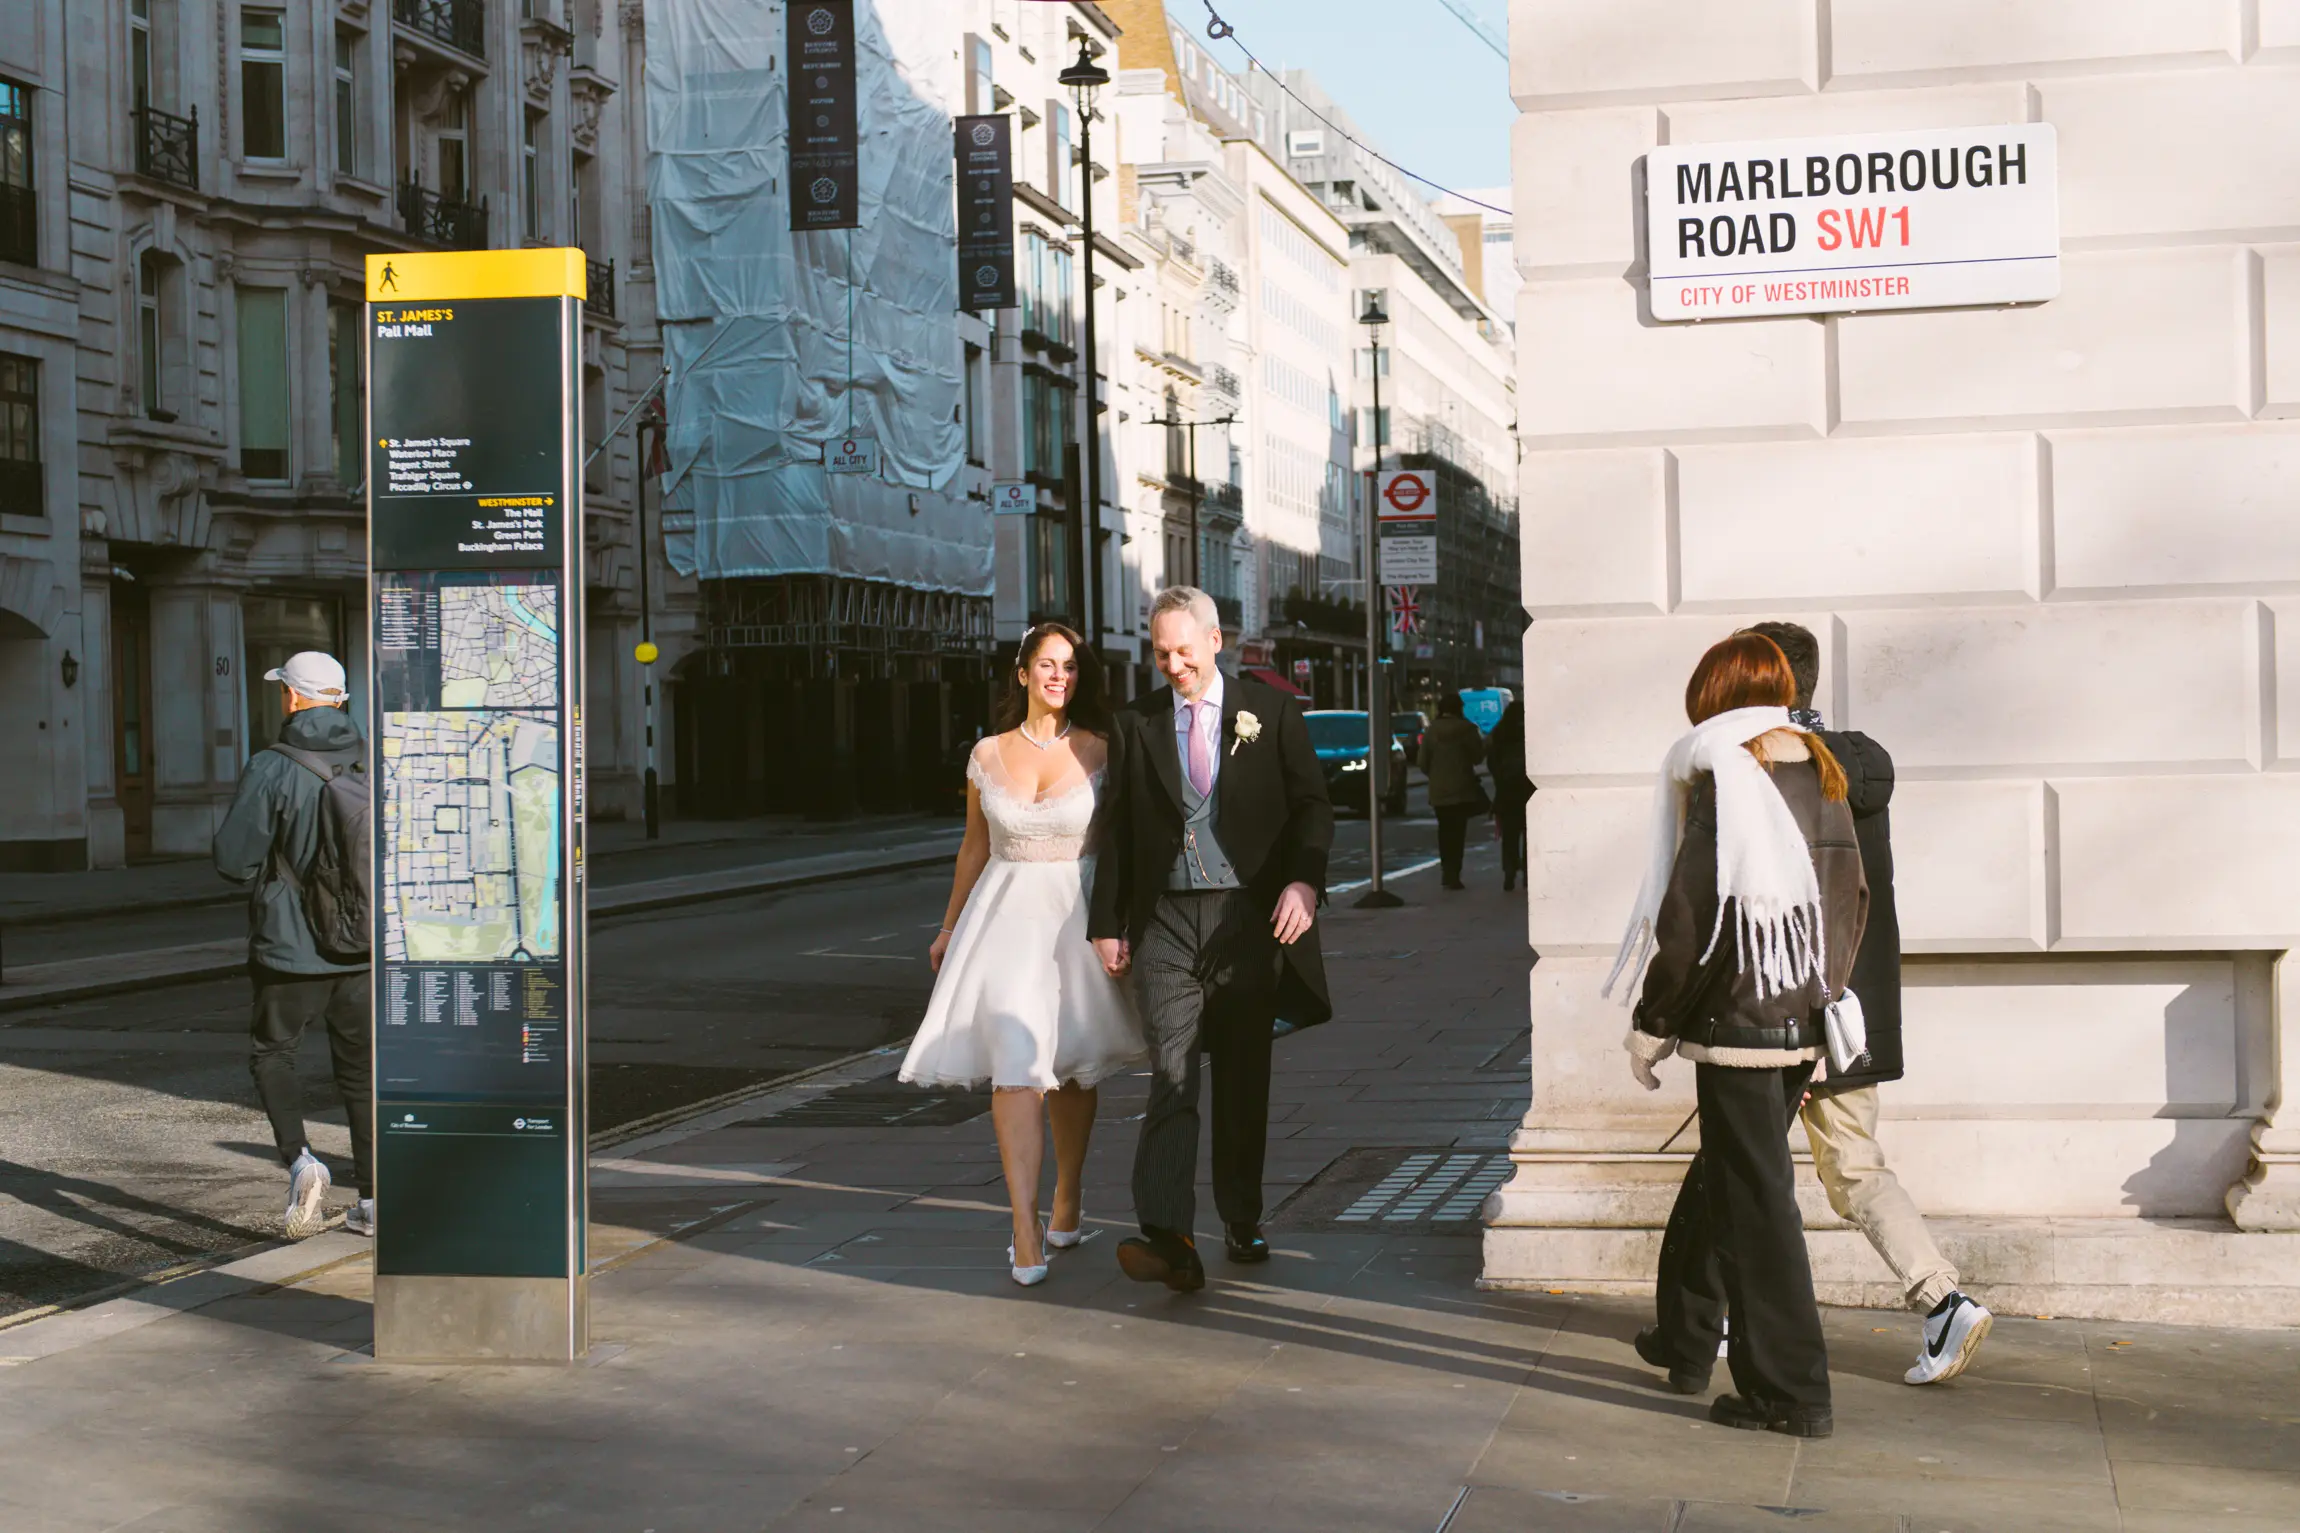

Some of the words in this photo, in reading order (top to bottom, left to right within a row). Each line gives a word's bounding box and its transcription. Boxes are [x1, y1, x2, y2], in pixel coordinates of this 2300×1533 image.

[1676, 143, 2027, 205] MARLBOROUGH
[1678, 212, 1797, 258] ROAD
[1816, 205, 1911, 251] SW1
[1680, 286, 1723, 306] CITY
[1732, 284, 1756, 304] OF
[1764, 276, 1910, 302] WESTMINSTER
[377, 310, 397, 323] ST.
[399, 308, 454, 323] JAMES'S
[377, 325, 402, 338] Pall
[404, 323, 433, 337] Mall
[388, 438, 402, 448] St.
[403, 438, 438, 448] James's
[439, 437, 471, 448] Square
[388, 449, 431, 459] Waterloo
[432, 448, 457, 458] Place
[833, 455, 847, 465] ALL
[848, 454, 868, 465] CITY
[388, 460, 421, 471] Regent
[422, 459, 451, 469] Street
[388, 471, 428, 482] Trafalgar
[429, 470, 461, 481] Square
[388, 482, 431, 493] Piccadilly
[432, 481, 461, 491] Circus
[477, 497, 544, 507] WESTMINSTER
[503, 508, 522, 518] The
[522, 507, 544, 518] Mall
[471, 520, 485, 530] St.
[486, 519, 522, 529] James's
[522, 519, 544, 529] Park
[493, 530, 522, 540] Green
[522, 530, 544, 540] Park
[457, 542, 512, 553] Buckingham
[513, 541, 544, 551] Palace
[216, 656, 230, 676] 50
